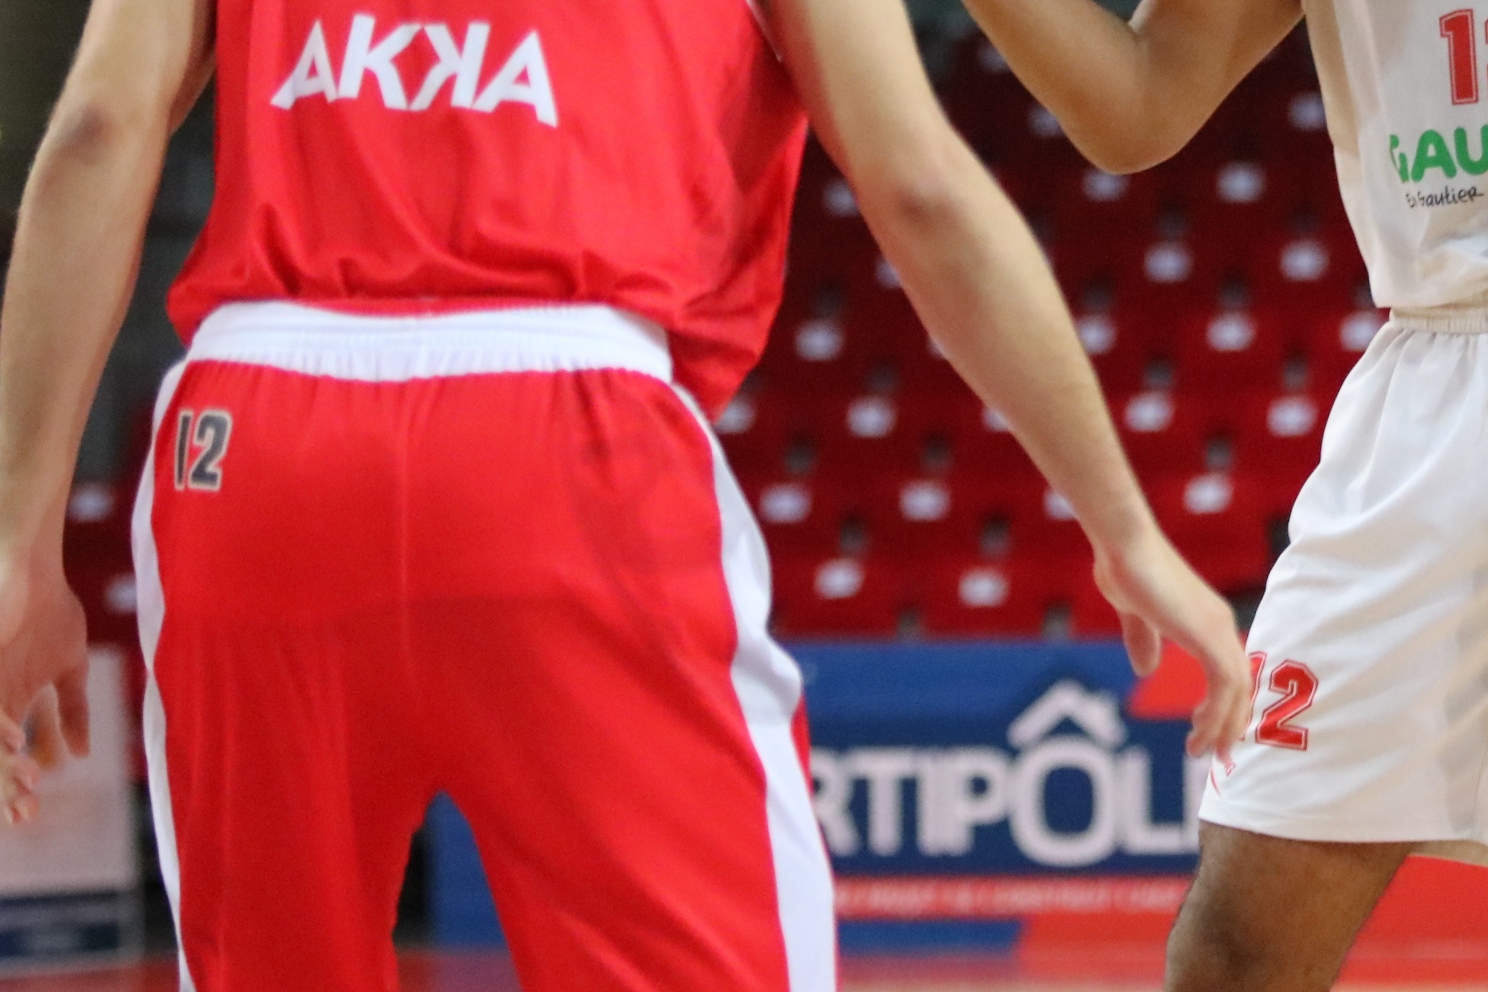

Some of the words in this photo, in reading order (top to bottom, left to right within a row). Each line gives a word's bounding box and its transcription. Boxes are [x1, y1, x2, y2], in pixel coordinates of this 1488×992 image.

[269, 12, 559, 128] AKKA
[174, 409, 233, 491] 12
[806, 678, 1200, 867] RTIPÔL
